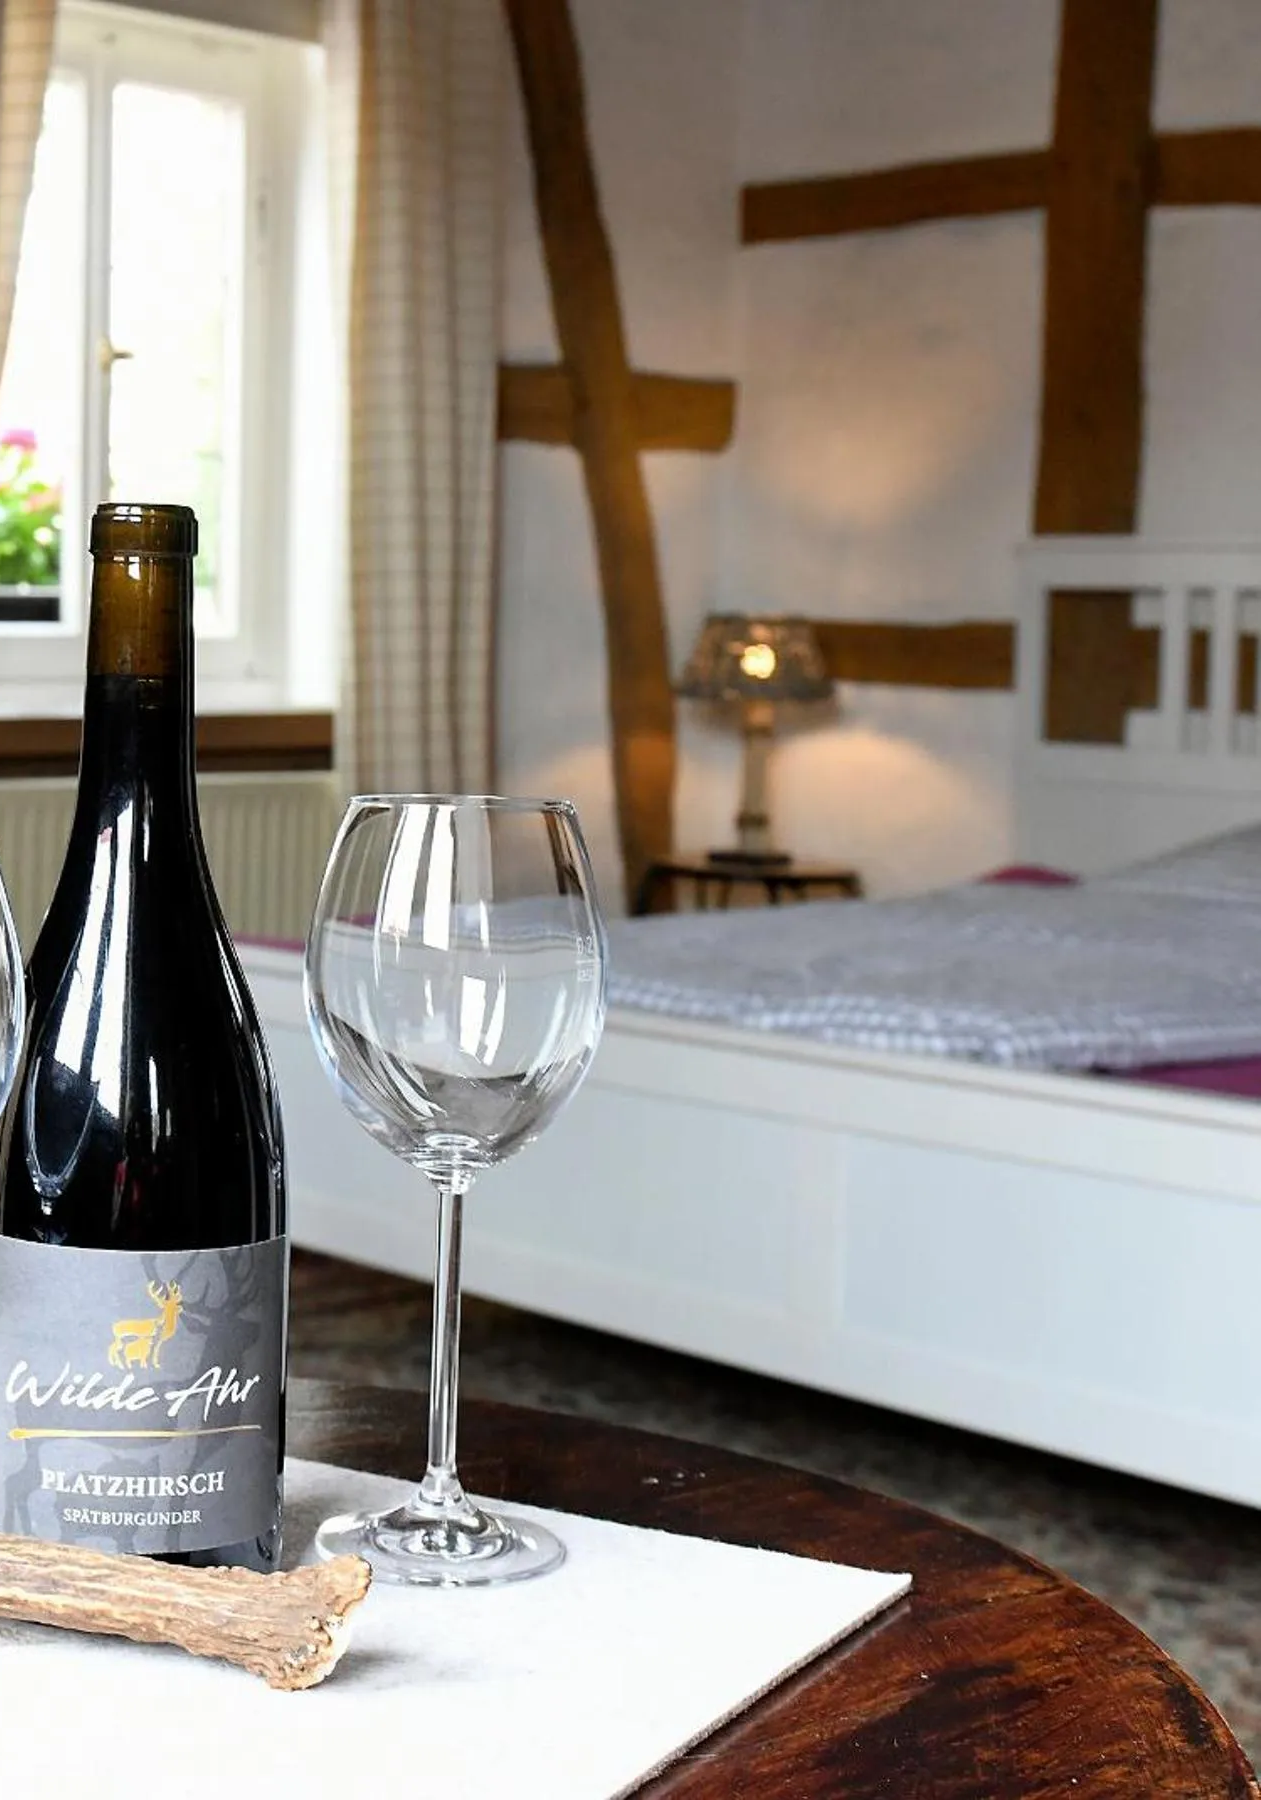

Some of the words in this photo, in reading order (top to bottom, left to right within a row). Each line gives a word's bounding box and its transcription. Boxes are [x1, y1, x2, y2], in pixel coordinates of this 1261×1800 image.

[5, 1360, 161, 1411] Wilde
[164, 1365, 260, 1421] Ahr
[41, 1468, 225, 1497] PLATZHIRSCH
[62, 1507, 202, 1526] SPÄTBURGUNDER
